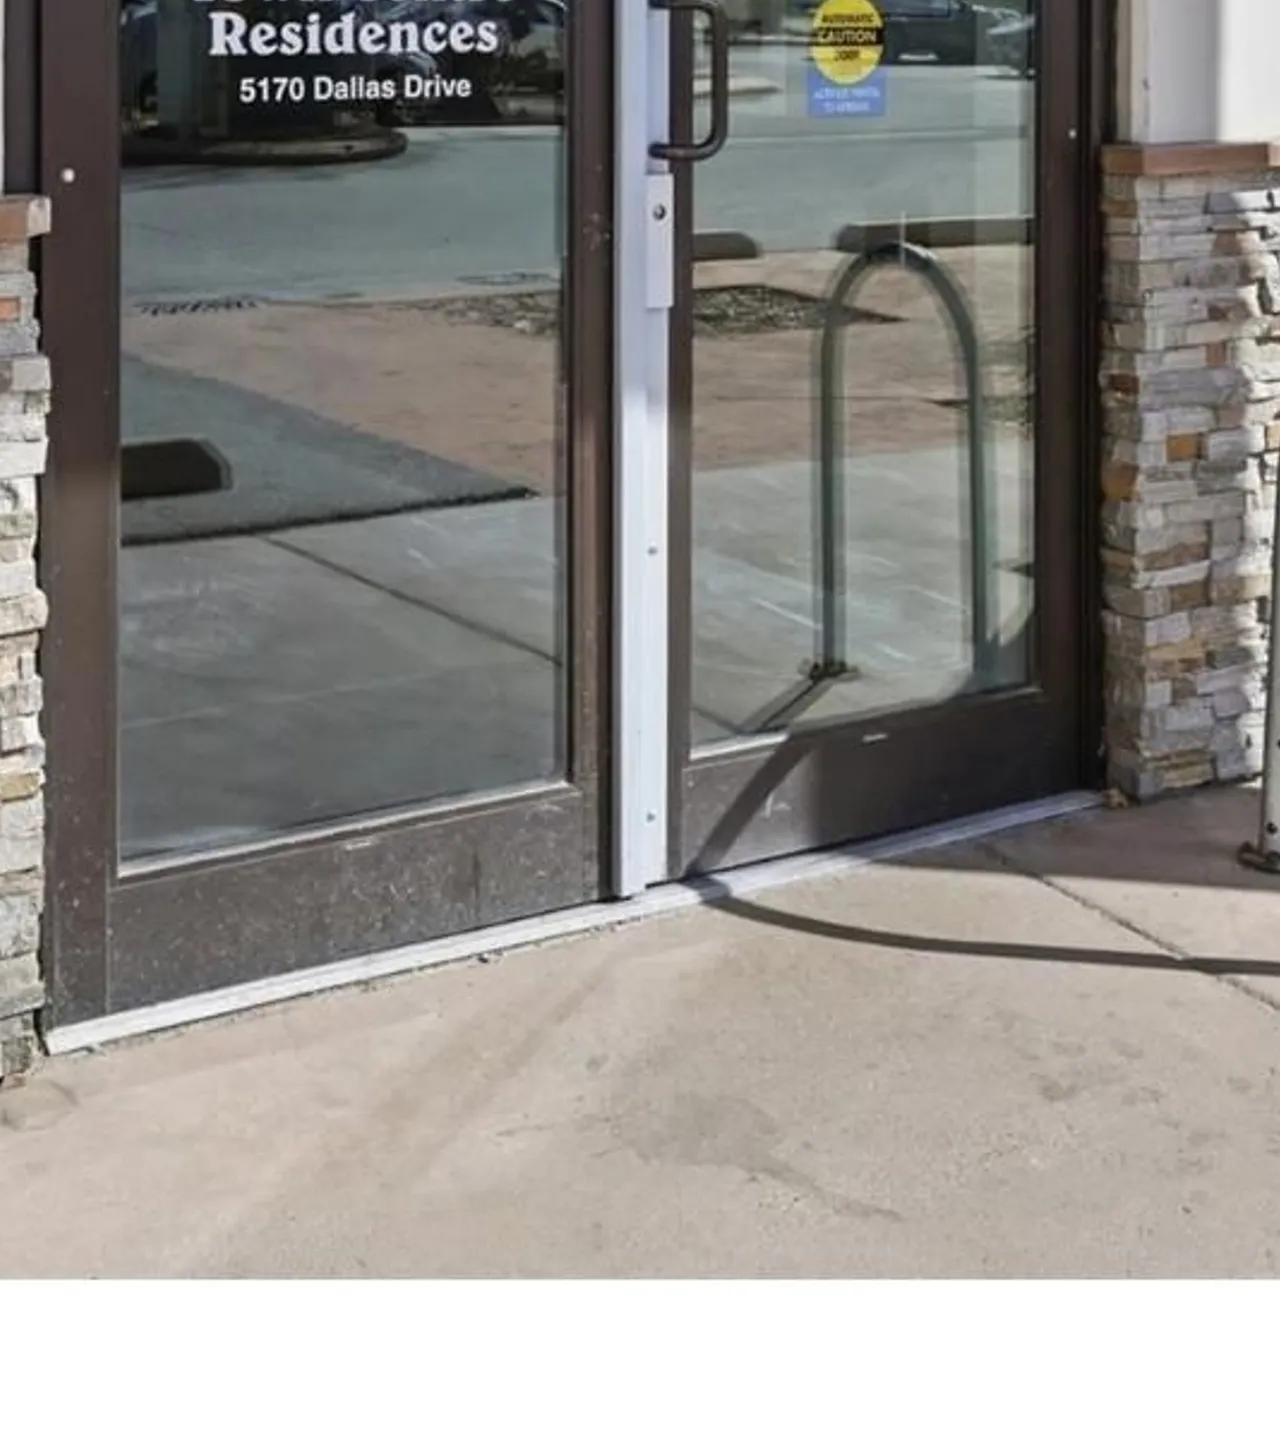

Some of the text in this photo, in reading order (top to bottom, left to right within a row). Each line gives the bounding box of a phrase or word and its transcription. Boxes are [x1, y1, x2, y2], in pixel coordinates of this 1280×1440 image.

[207, 10, 500, 56] Residences
[817, 29, 877, 43] CAUTION
[239, 74, 472, 102] 5170 Dallas Drive
